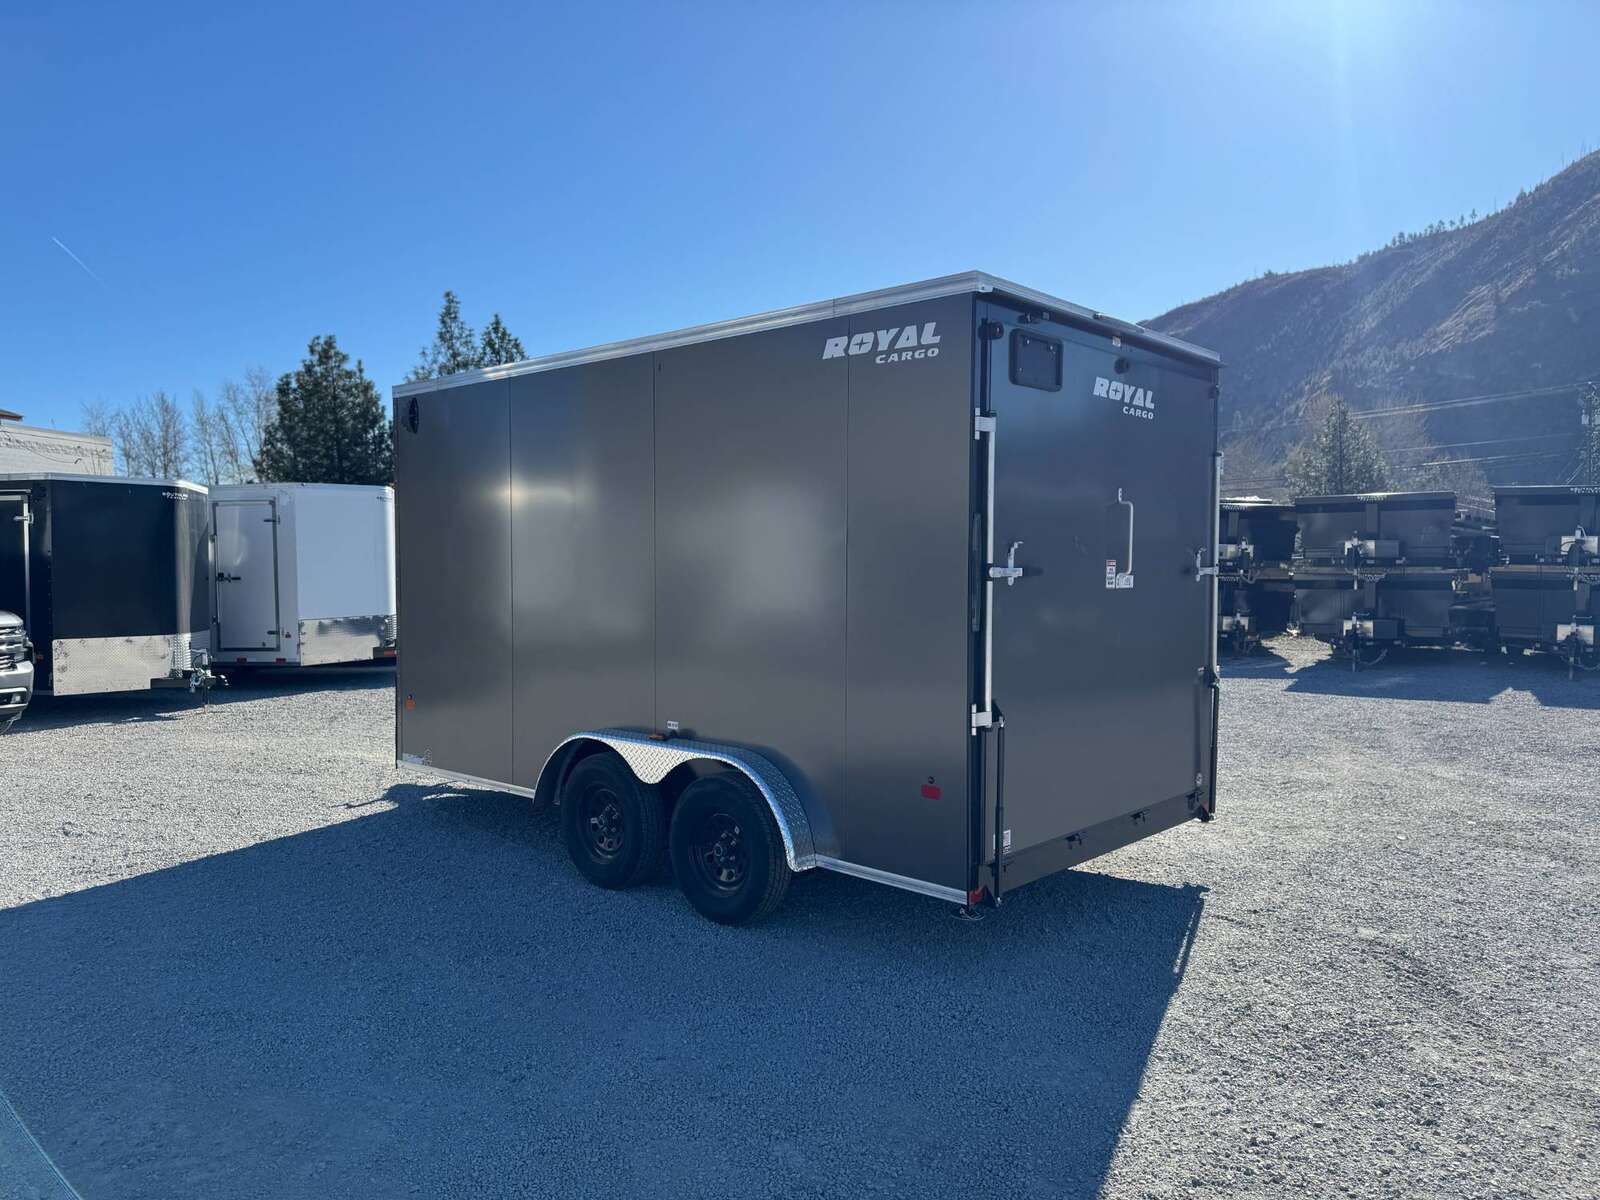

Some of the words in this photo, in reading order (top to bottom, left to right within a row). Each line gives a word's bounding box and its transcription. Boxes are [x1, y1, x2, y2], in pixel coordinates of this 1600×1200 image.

[822, 322, 941, 359] ROYAL
[875, 347, 939, 364] CARGO
[1093, 376, 1155, 409] ROYAL
[1122, 406, 1154, 420] CARGO
